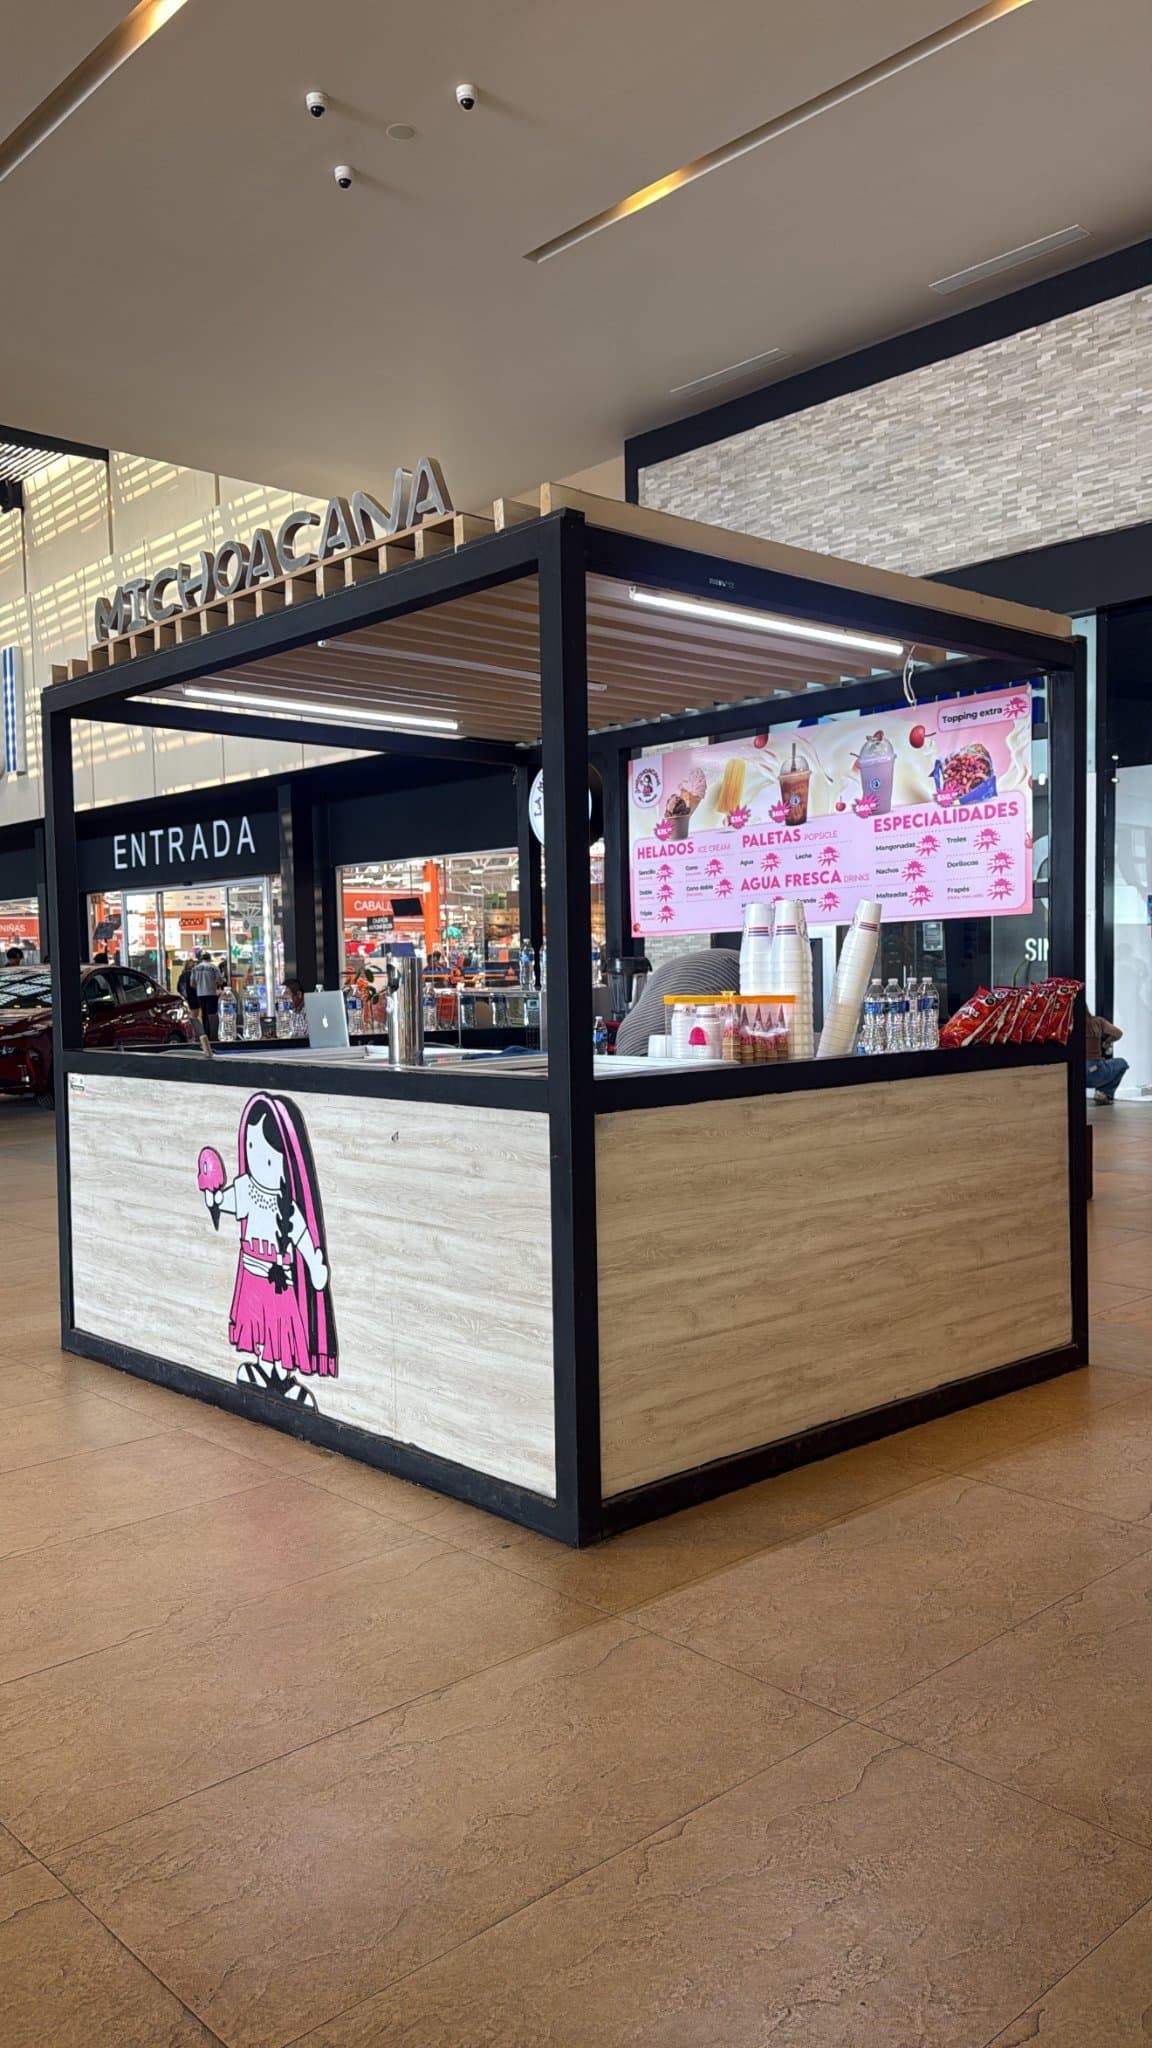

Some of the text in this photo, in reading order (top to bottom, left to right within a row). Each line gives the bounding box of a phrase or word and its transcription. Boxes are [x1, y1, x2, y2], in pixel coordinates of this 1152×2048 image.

[95, 456, 455, 644] MICHOACANA
[942, 711, 978, 724] Topping
[979, 707, 1003, 717] extra
[874, 801, 1019, 833] ESPECIALIDADES
[113, 816, 256, 870] ENTRADA
[742, 829, 838, 848] PALETAS POPSICLE
[875, 842, 916, 852] Mangonadas
[637, 841, 694, 860] HELADOS
[875, 867, 899, 875] Nachos
[741, 876, 781, 891] AGUA
[785, 870, 841, 888] FRESCA
[843, 873, 870, 883] DRINKS
[947, 885, 970, 894] Frapés
[876, 891, 908, 899] Malteadas
[354, 900, 394, 912] CABALL
